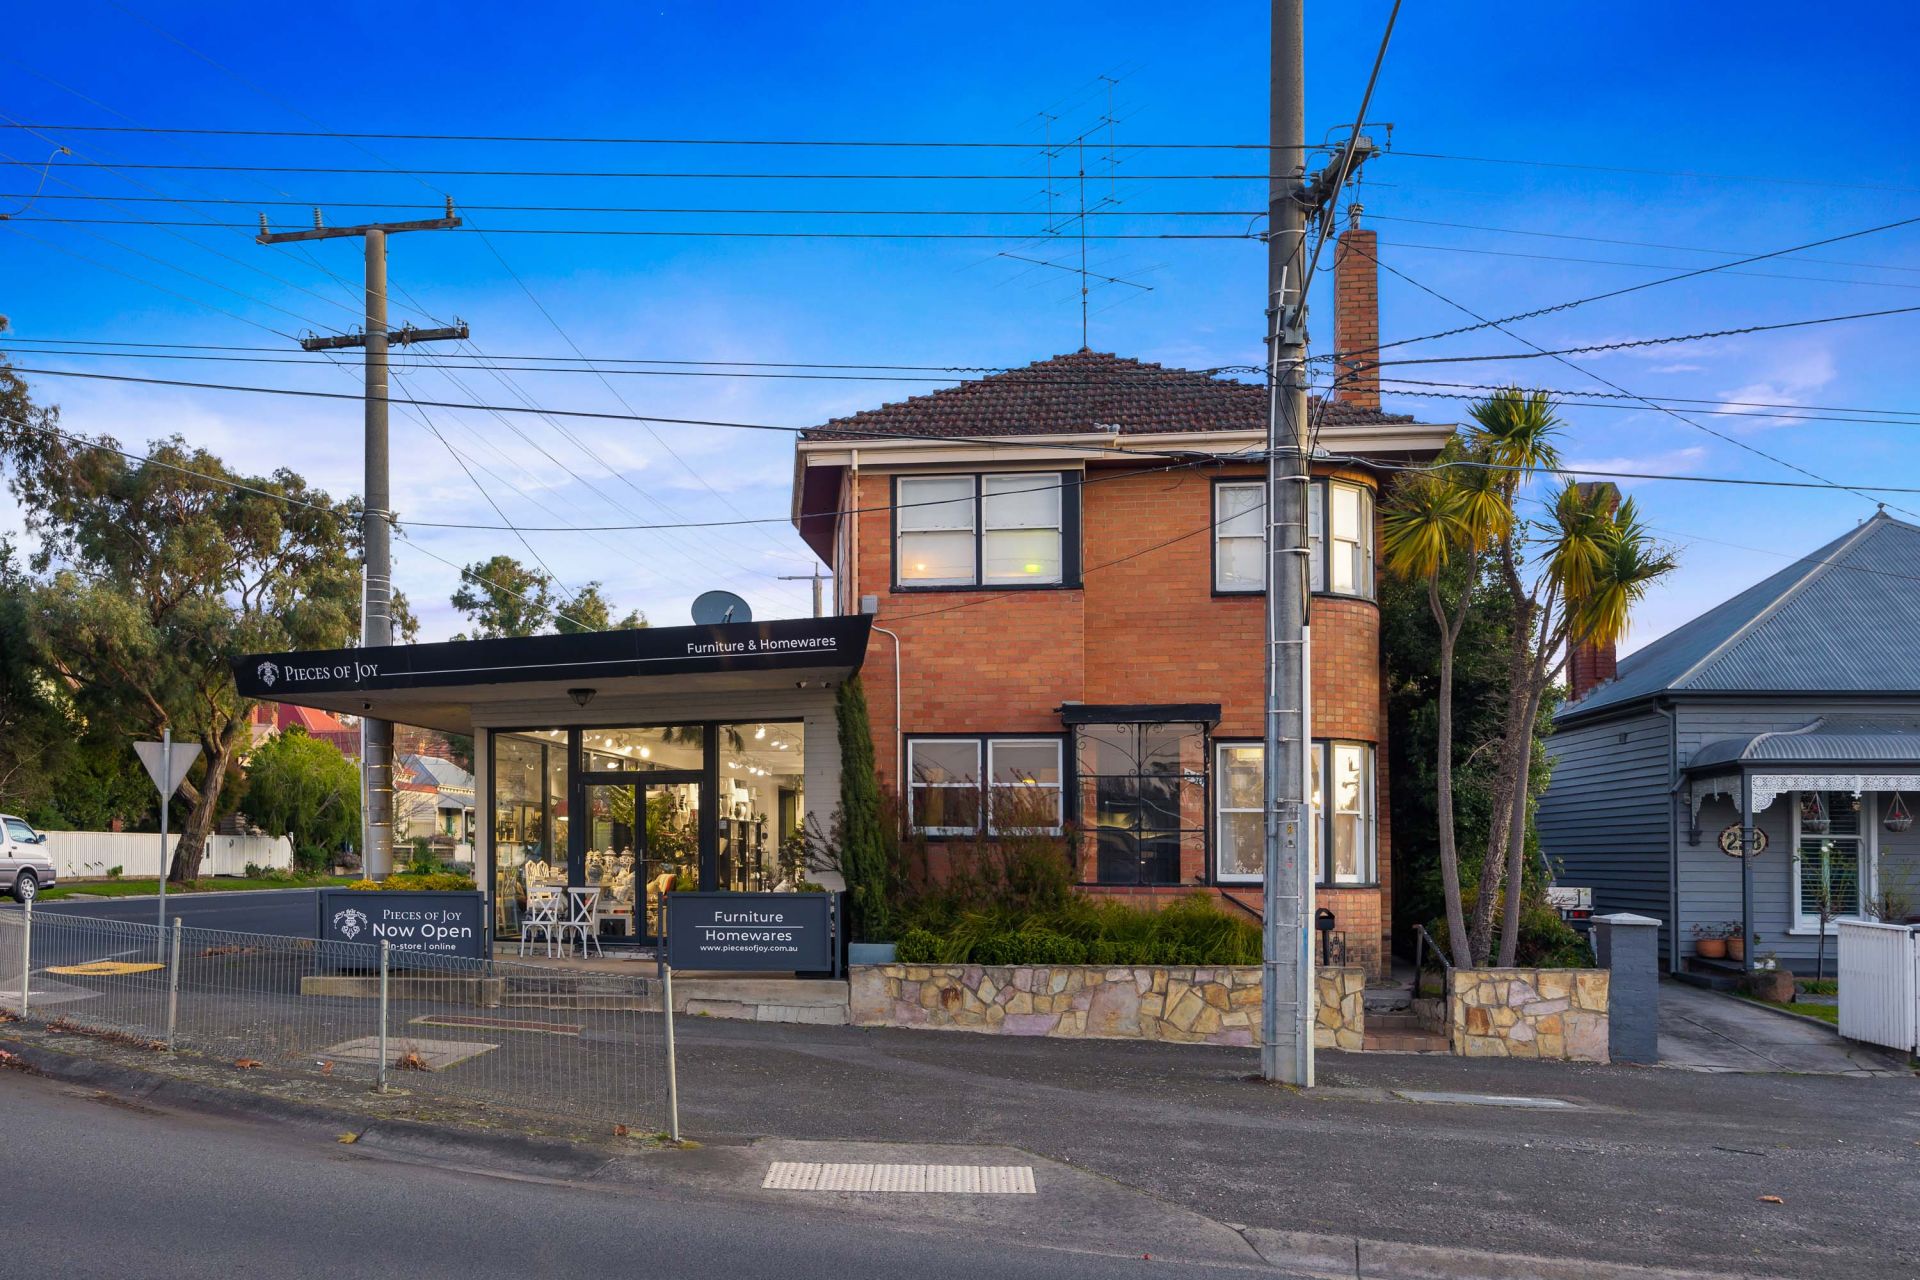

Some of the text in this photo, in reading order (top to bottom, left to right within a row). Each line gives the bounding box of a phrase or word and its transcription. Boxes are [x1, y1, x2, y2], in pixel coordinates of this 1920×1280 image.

[687, 636, 836, 654] Furniture & Homewares
[285, 665, 330, 682] PIECES
[353, 661, 379, 683] JOY
[383, 909, 422, 921] PIECES
[441, 909, 463, 924] JOY
[714, 911, 784, 923] Furniture
[372, 923, 472, 941] Now Open
[705, 930, 793, 941] Homewares
[388, 942, 457, 951] in-store online
[699, 944, 798, 953] www.piecesofjoy.com.au
